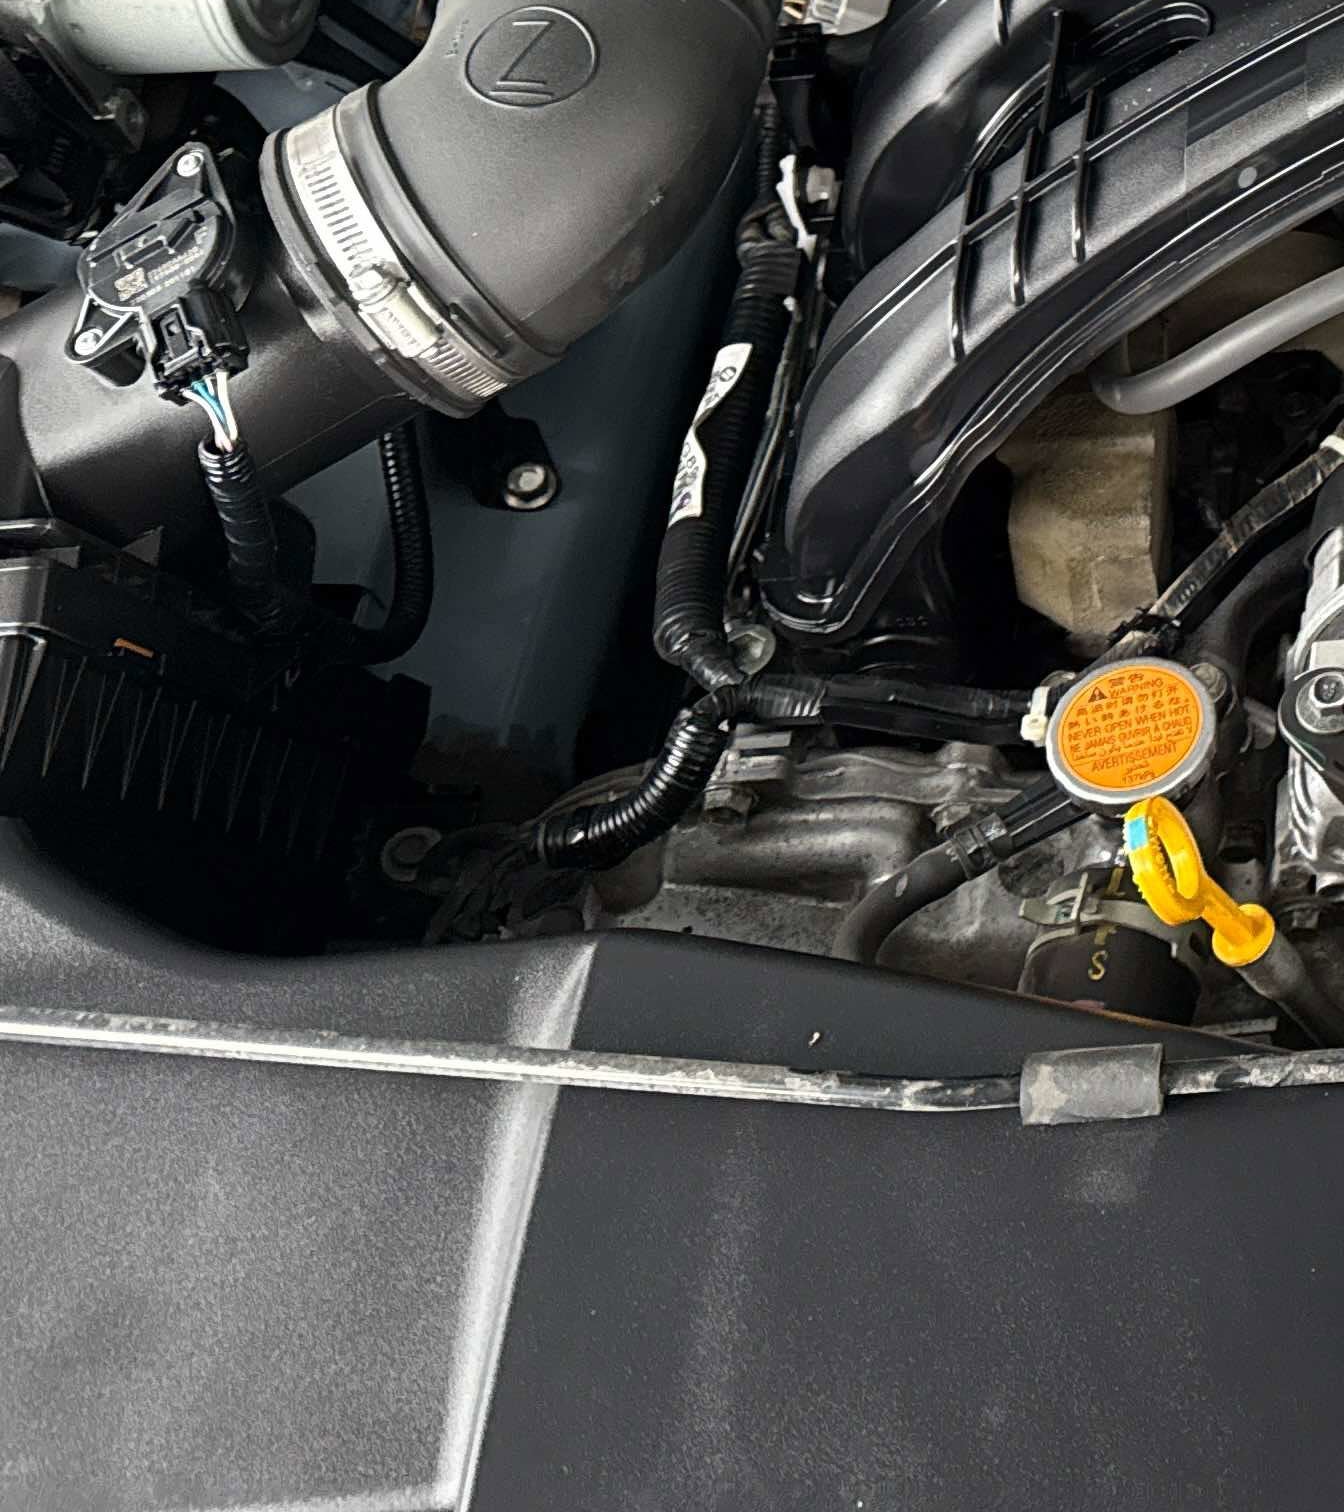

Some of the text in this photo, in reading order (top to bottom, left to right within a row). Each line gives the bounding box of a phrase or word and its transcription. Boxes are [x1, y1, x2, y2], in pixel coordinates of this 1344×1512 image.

[1108, 676, 1164, 699] WARNING
[1067, 726, 1102, 742] NEVER
[1105, 718, 1132, 733] OPEN
[1135, 710, 1166, 725] WHEN
[1089, 740, 1178, 772] AVERTISSEMENT
